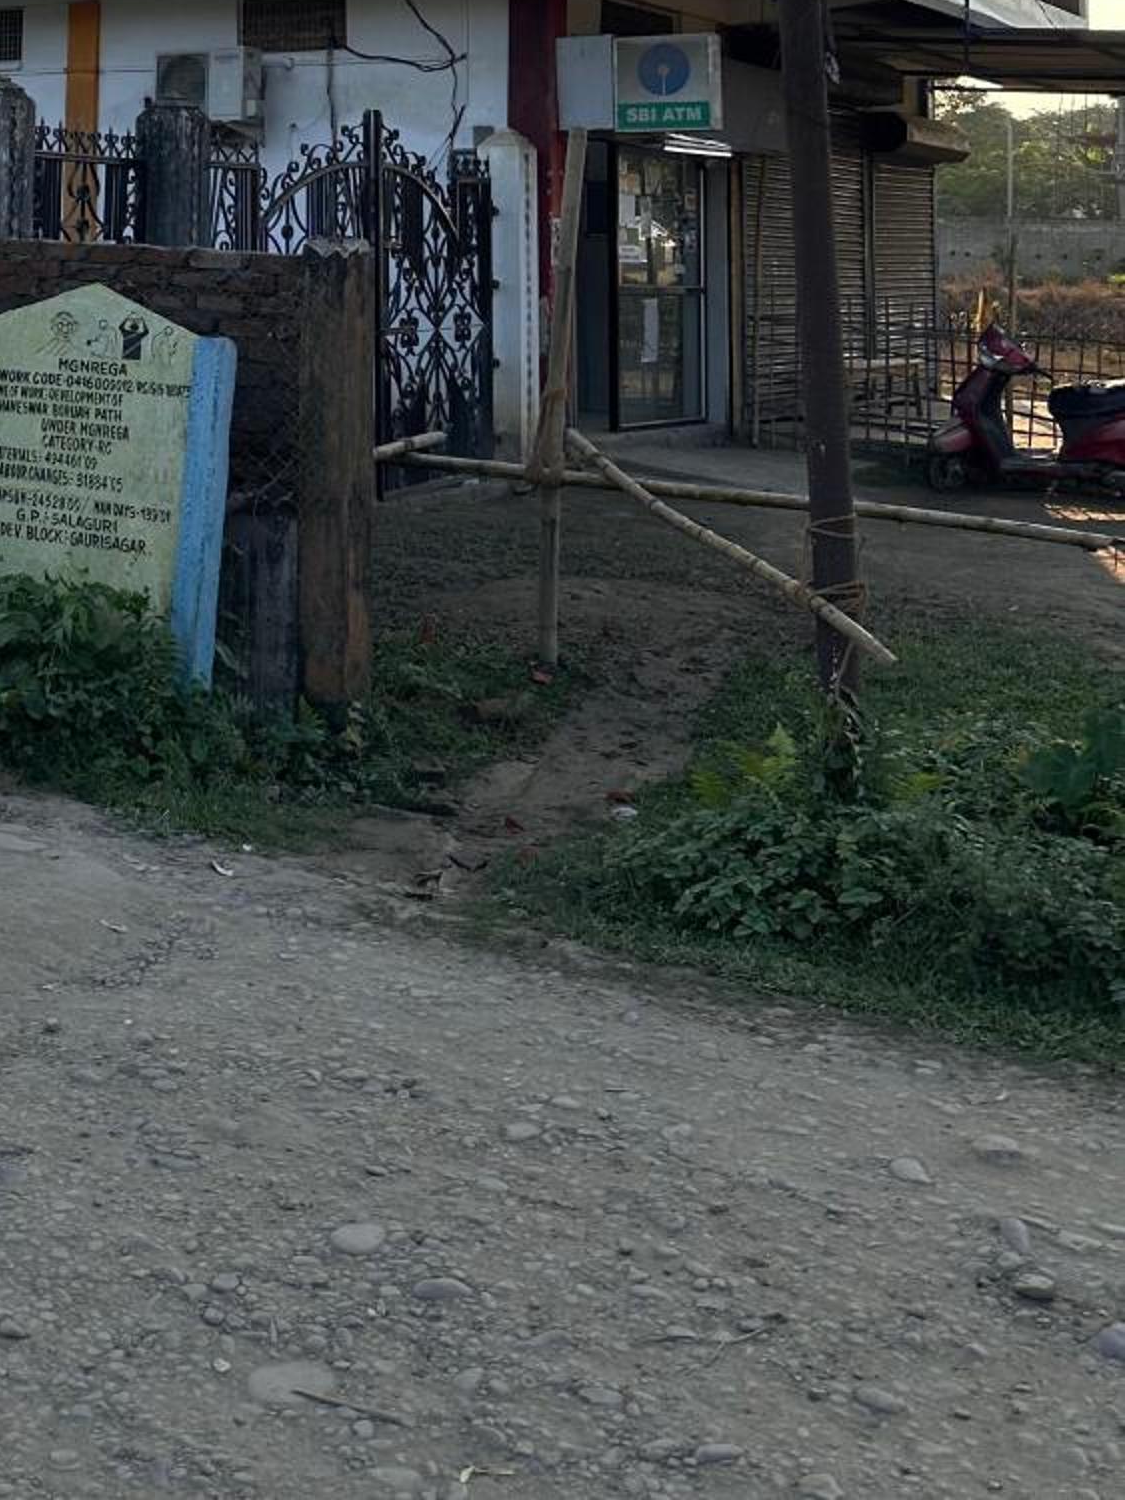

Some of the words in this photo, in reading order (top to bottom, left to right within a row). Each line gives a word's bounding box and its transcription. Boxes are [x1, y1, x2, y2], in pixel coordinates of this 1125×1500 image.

[626, 106, 656, 123] SBI
[662, 106, 701, 121] ATM
[58, 357, 128, 377] MGNREGA
[94, 407, 123, 422] PATH
[40, 417, 75, 435] UNDER
[80, 421, 130, 441] MGNREGA
